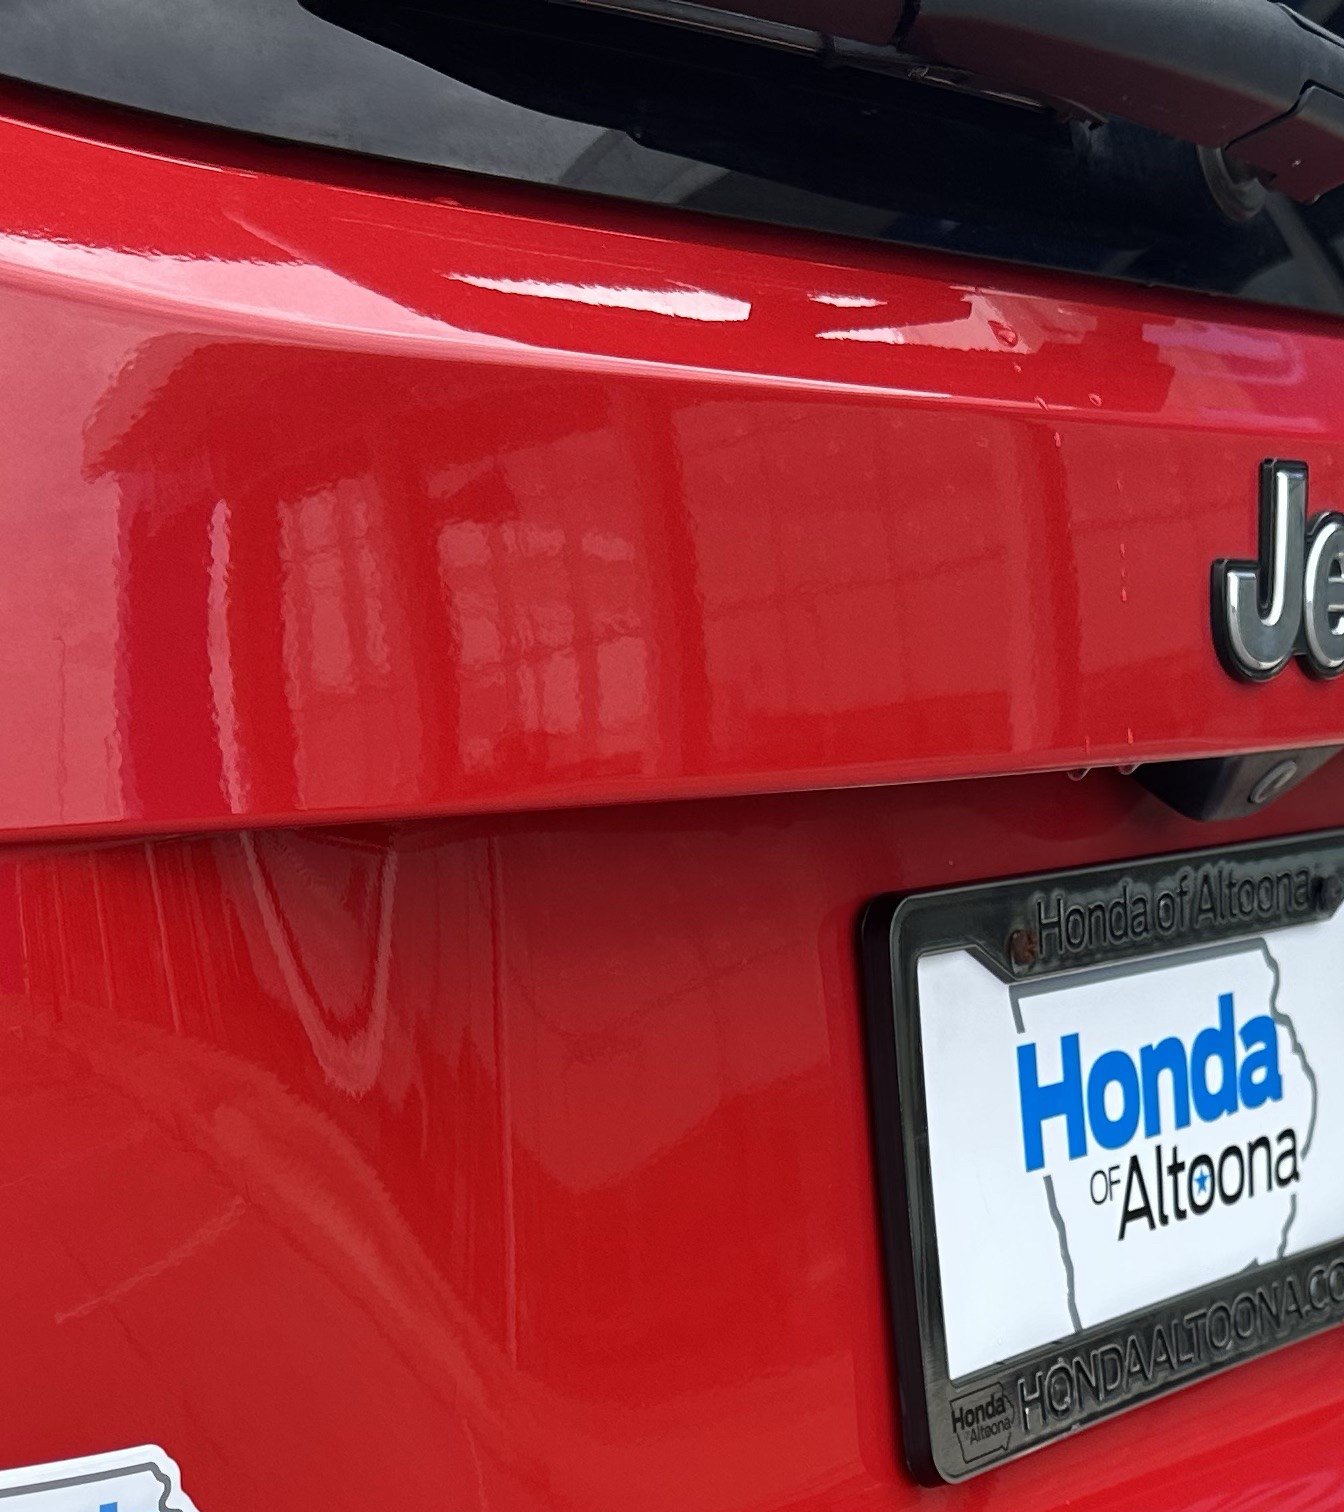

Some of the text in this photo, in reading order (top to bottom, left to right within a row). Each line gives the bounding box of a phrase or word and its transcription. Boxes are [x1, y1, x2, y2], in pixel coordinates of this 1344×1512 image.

[1035, 862, 1311, 958] Honda of Altoona
[1017, 991, 1284, 1173] Honda
[1090, 1128, 1301, 1242] OF Altoona
[951, 1393, 1006, 1434] Honda
